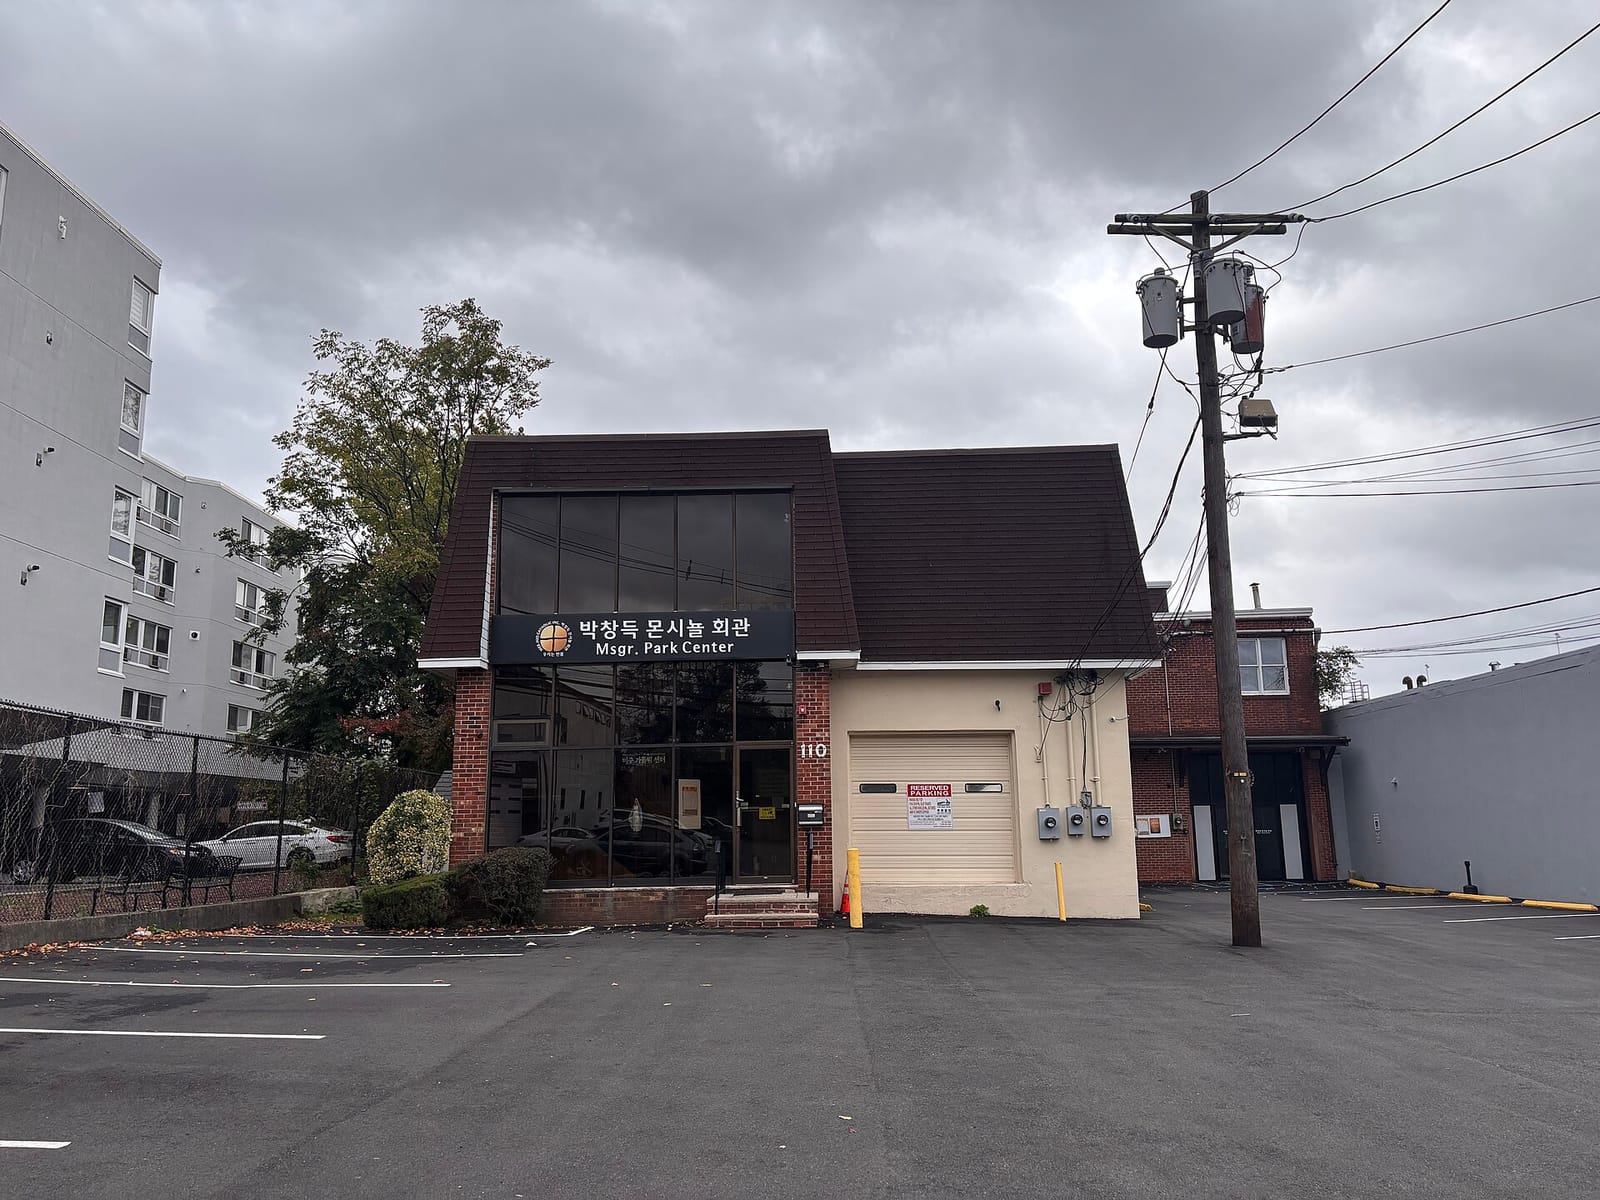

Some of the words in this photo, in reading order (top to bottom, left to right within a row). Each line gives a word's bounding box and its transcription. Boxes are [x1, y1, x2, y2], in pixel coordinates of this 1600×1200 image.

[579, 620, 639, 640] 박창득
[645, 618, 705, 639] 몬시뇰
[711, 617, 751, 637] 회관
[596, 642, 639, 657] Msgr.
[644, 641, 679, 654] Park
[682, 641, 734, 654] Center
[800, 743, 827, 758] 110
